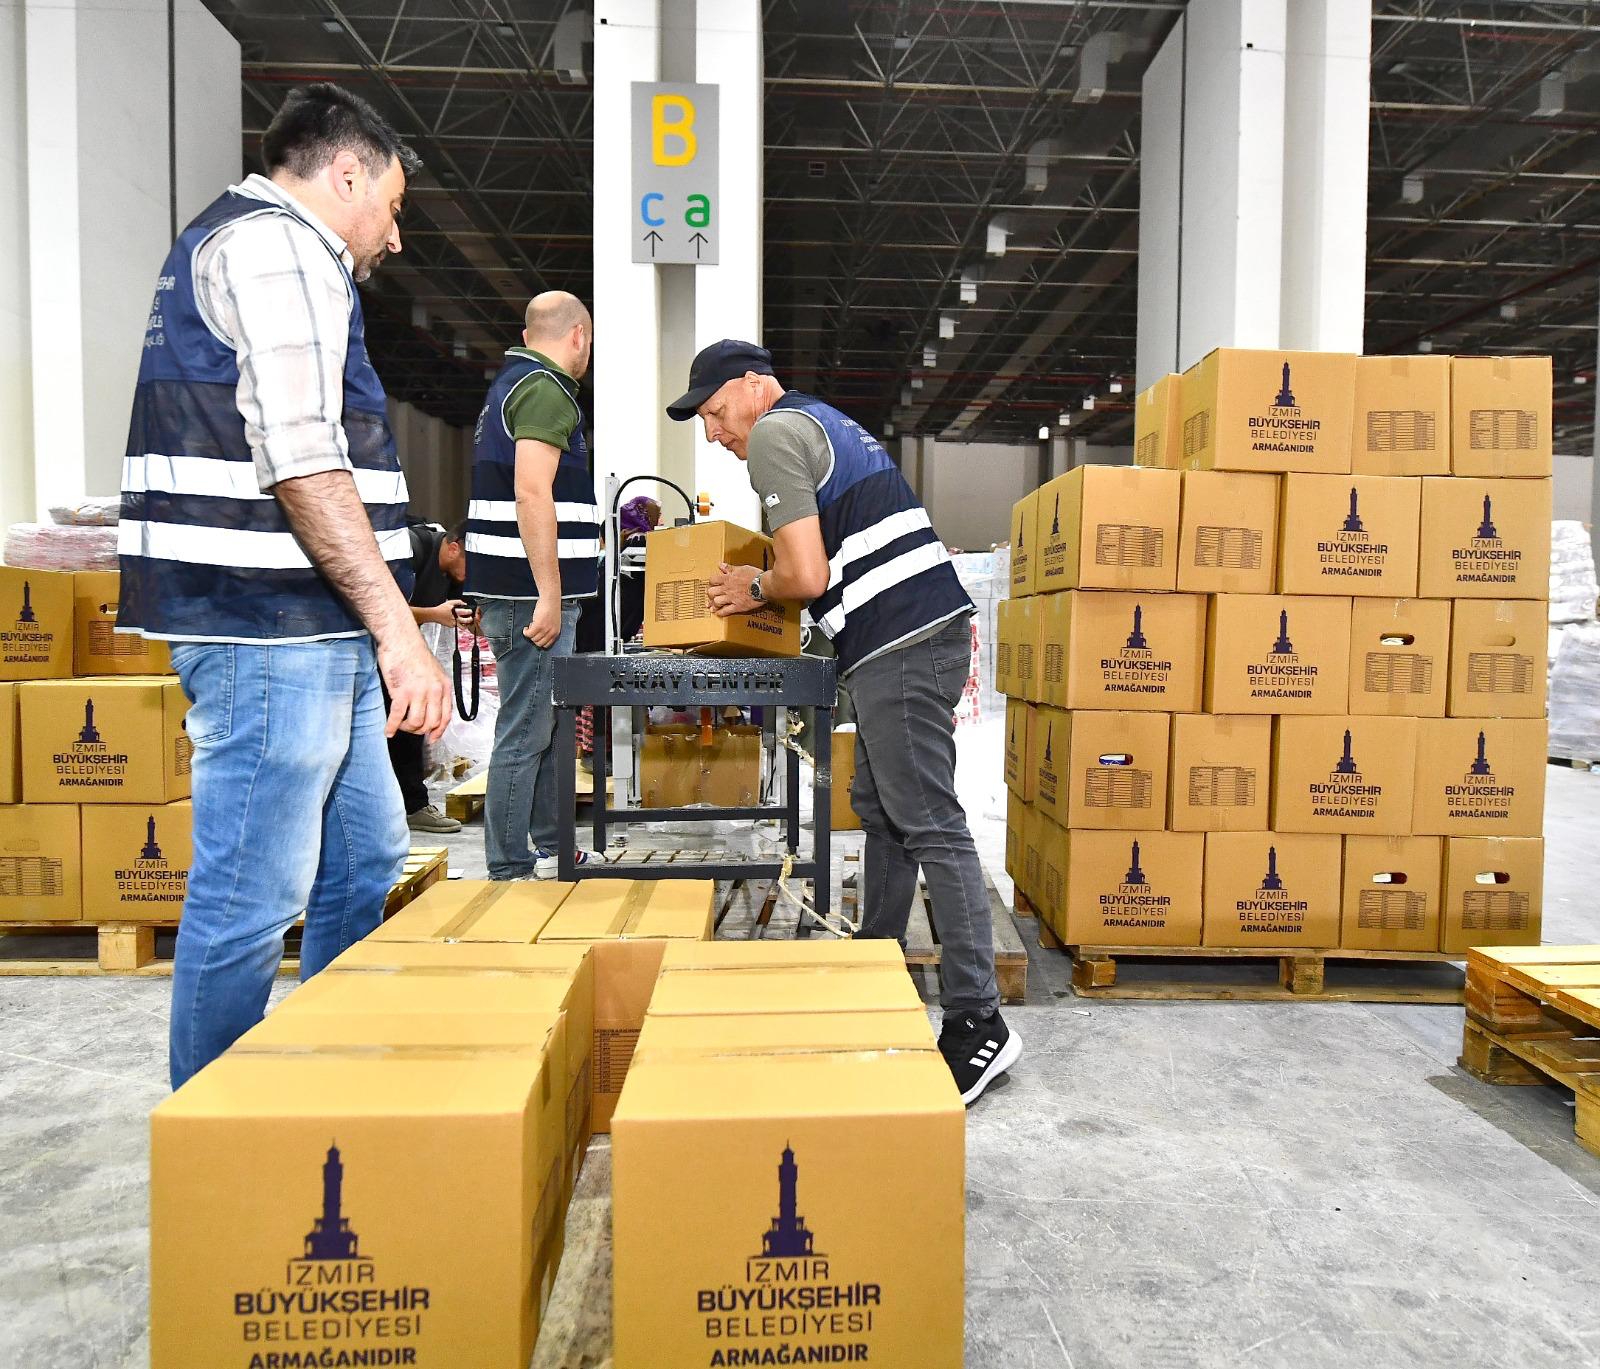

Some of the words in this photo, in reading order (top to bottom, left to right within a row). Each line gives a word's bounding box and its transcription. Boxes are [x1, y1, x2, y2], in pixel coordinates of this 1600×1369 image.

[652, 93, 698, 167] B
[685, 193, 710, 228] a
[1251, 429, 1317, 440] BELEDİYESİ
[1252, 442, 1314, 453] ARMAĞANIDIR
[1320, 554, 1385, 565] BELEDİYESİ
[1455, 560, 1518, 571] BELEDİYESİ
[1321, 566, 1382, 577] ARMAĞANIDIR
[1456, 572, 1516, 583] ARMAĞANIDIR
[1103, 670, 1168, 682] BELEDİYESİ
[1249, 676, 1314, 687] BELEDİYESİ
[609, 671, 684, 693] X-RAY
[691, 671, 784, 693] CENTER
[1104, 683, 1166, 694] ARMAĞANIDIR
[1251, 688, 1312, 699] ARMAĞANIDIR
[56, 764, 125, 775] BELEDİYESİ
[59, 777, 123, 787] ARMAĞANIDIR
[1312, 795, 1378, 806] BELEDİYESİ
[1447, 796, 1511, 807] BELEDİYESİ
[1312, 807, 1375, 818] ARMAĞANIDIR
[1449, 808, 1509, 819] ARMAĞANIDIR
[118, 880, 186, 891] BELEDİYESİ
[1102, 905, 1167, 916] BELEDİYESİ
[1239, 911, 1304, 922] BELEDİYESİ
[1103, 918, 1165, 929] ARMAĞANIDIR
[1240, 923, 1302, 934] ARMAĞANIDIR
[286, 1262, 375, 1286] İZMİR
[746, 1259, 829, 1283] İZMİR
[234, 1286, 430, 1316] BÜYÜKŞEHİR
[697, 1281, 881, 1313] BÜYÜKŞEHİR
[243, 1314, 421, 1342] BELEDİYESİ
[706, 1309, 872, 1339] BELEDİYESİ
[248, 1346, 417, 1369] ARMAĞANIDIR
[710, 1343, 868, 1368] ARMAĞANIDIR
